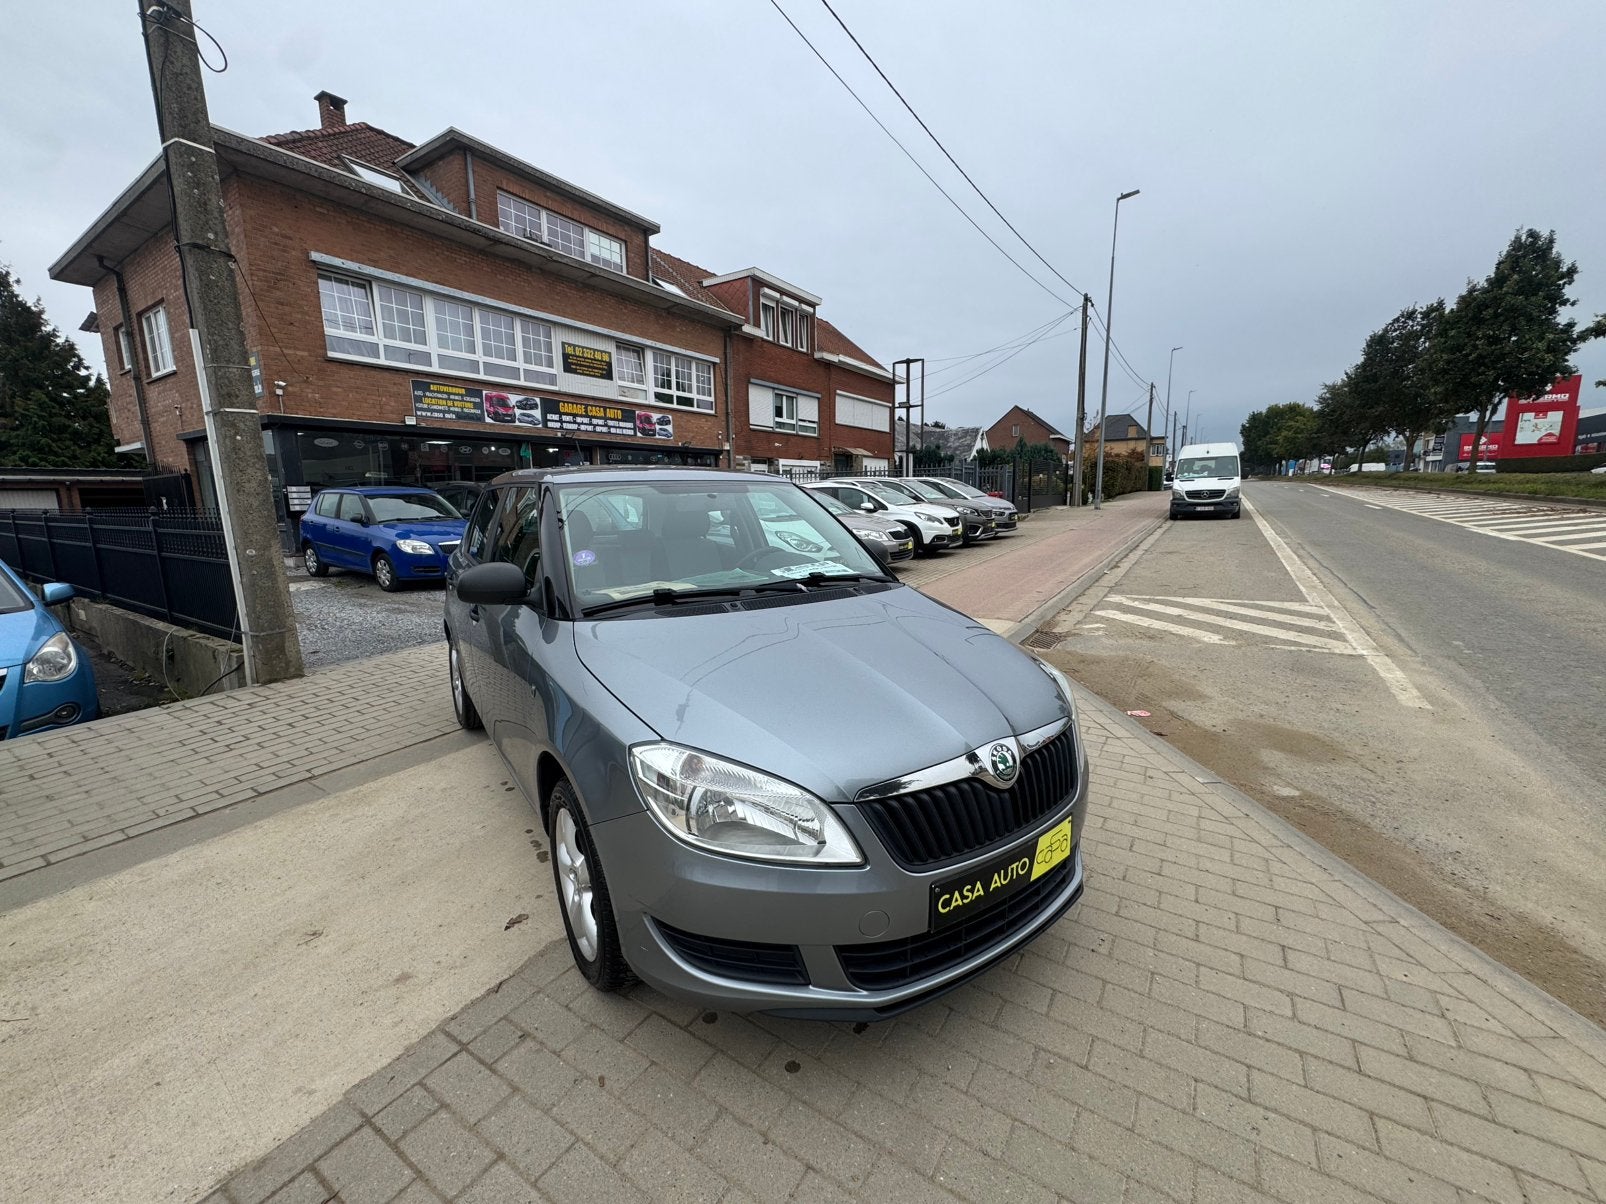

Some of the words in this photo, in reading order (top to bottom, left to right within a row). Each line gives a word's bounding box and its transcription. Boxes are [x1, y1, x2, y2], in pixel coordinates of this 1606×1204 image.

[559, 402, 586, 414] GARAGE
[587, 405, 604, 417] CASA
[606, 408, 622, 419] AUTO
[938, 880, 985, 914] CASA
[989, 857, 1030, 892] AUTO
